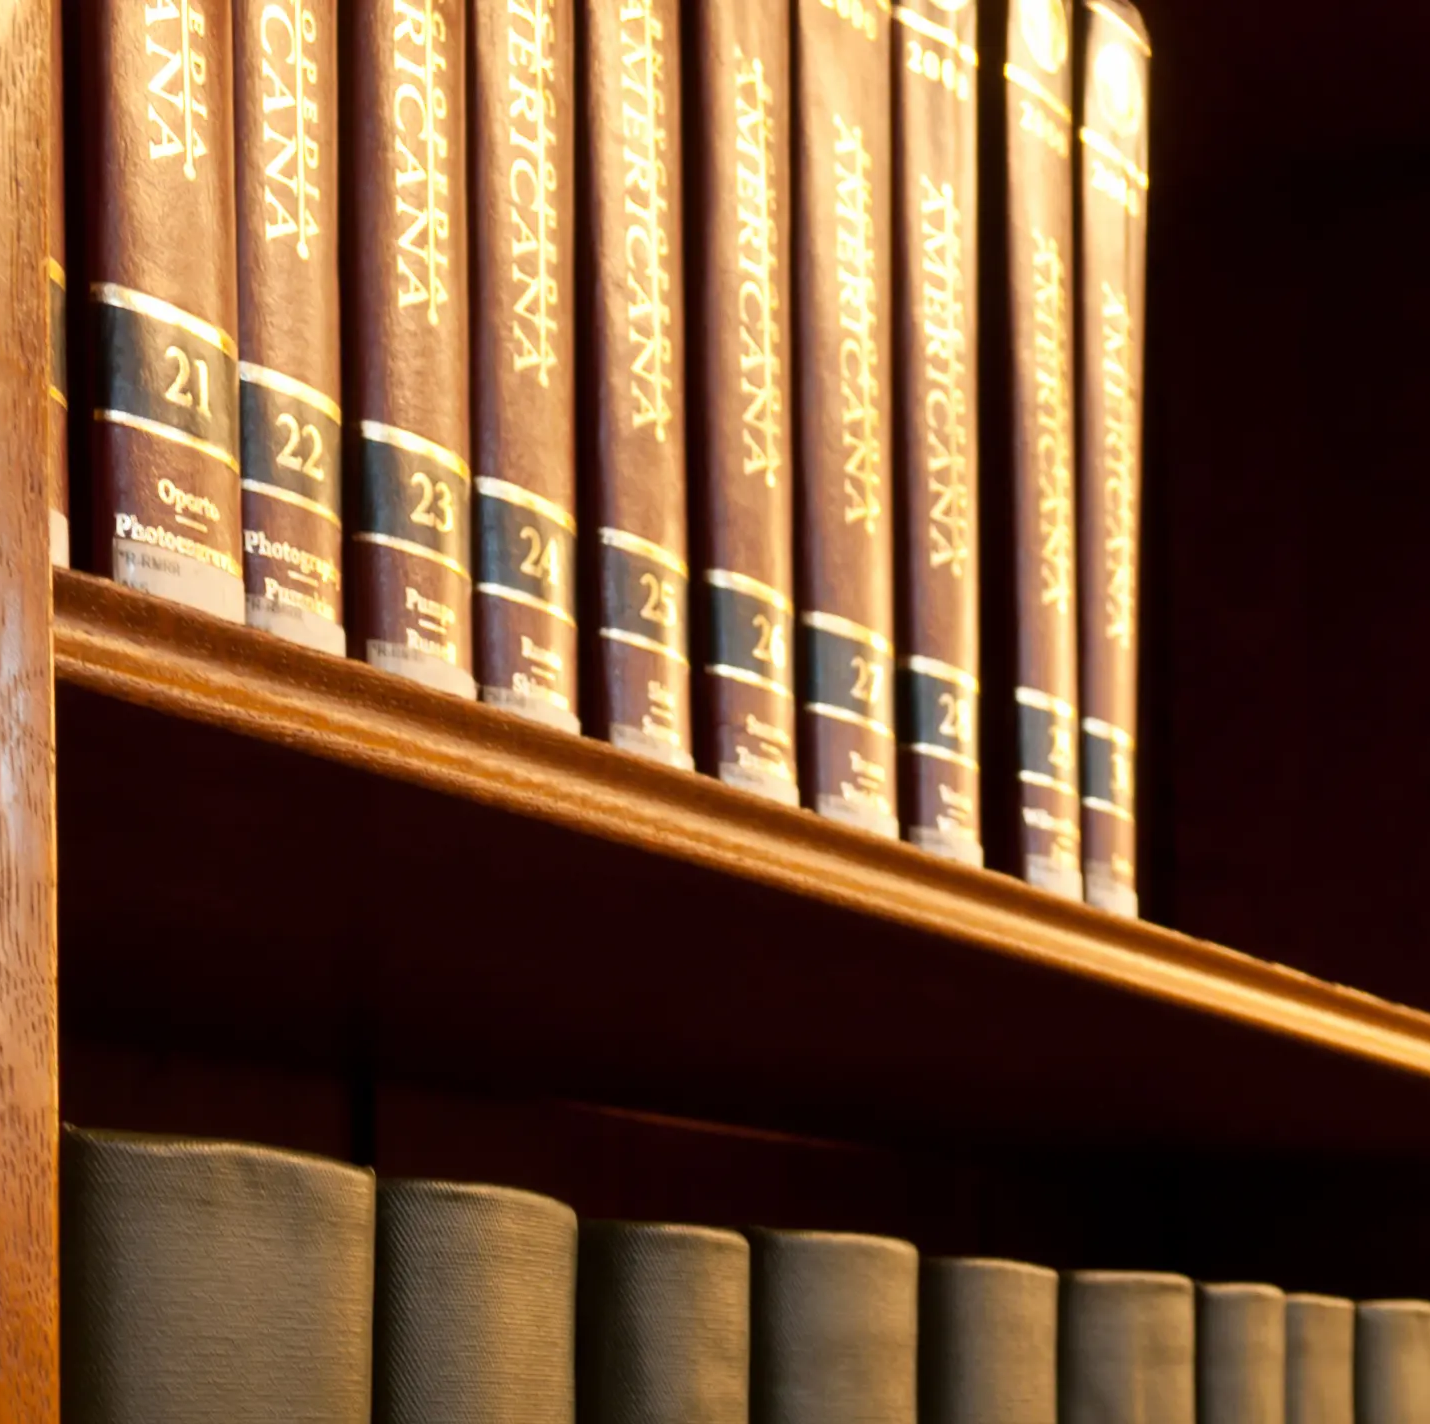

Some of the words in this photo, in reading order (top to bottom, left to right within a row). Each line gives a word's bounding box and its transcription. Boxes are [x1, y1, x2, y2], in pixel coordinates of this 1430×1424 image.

[732, 45, 772, 477] AMERICANA
[832, 112, 871, 526] AMERICANA
[163, 344, 212, 422] 21
[919, 173, 958, 568] AMERICANA
[275, 412, 325, 483] 22
[409, 471, 455, 534] 23
[519, 525, 560, 587] 24
[638, 571, 678, 628] 25
[849, 654, 884, 704] 27
